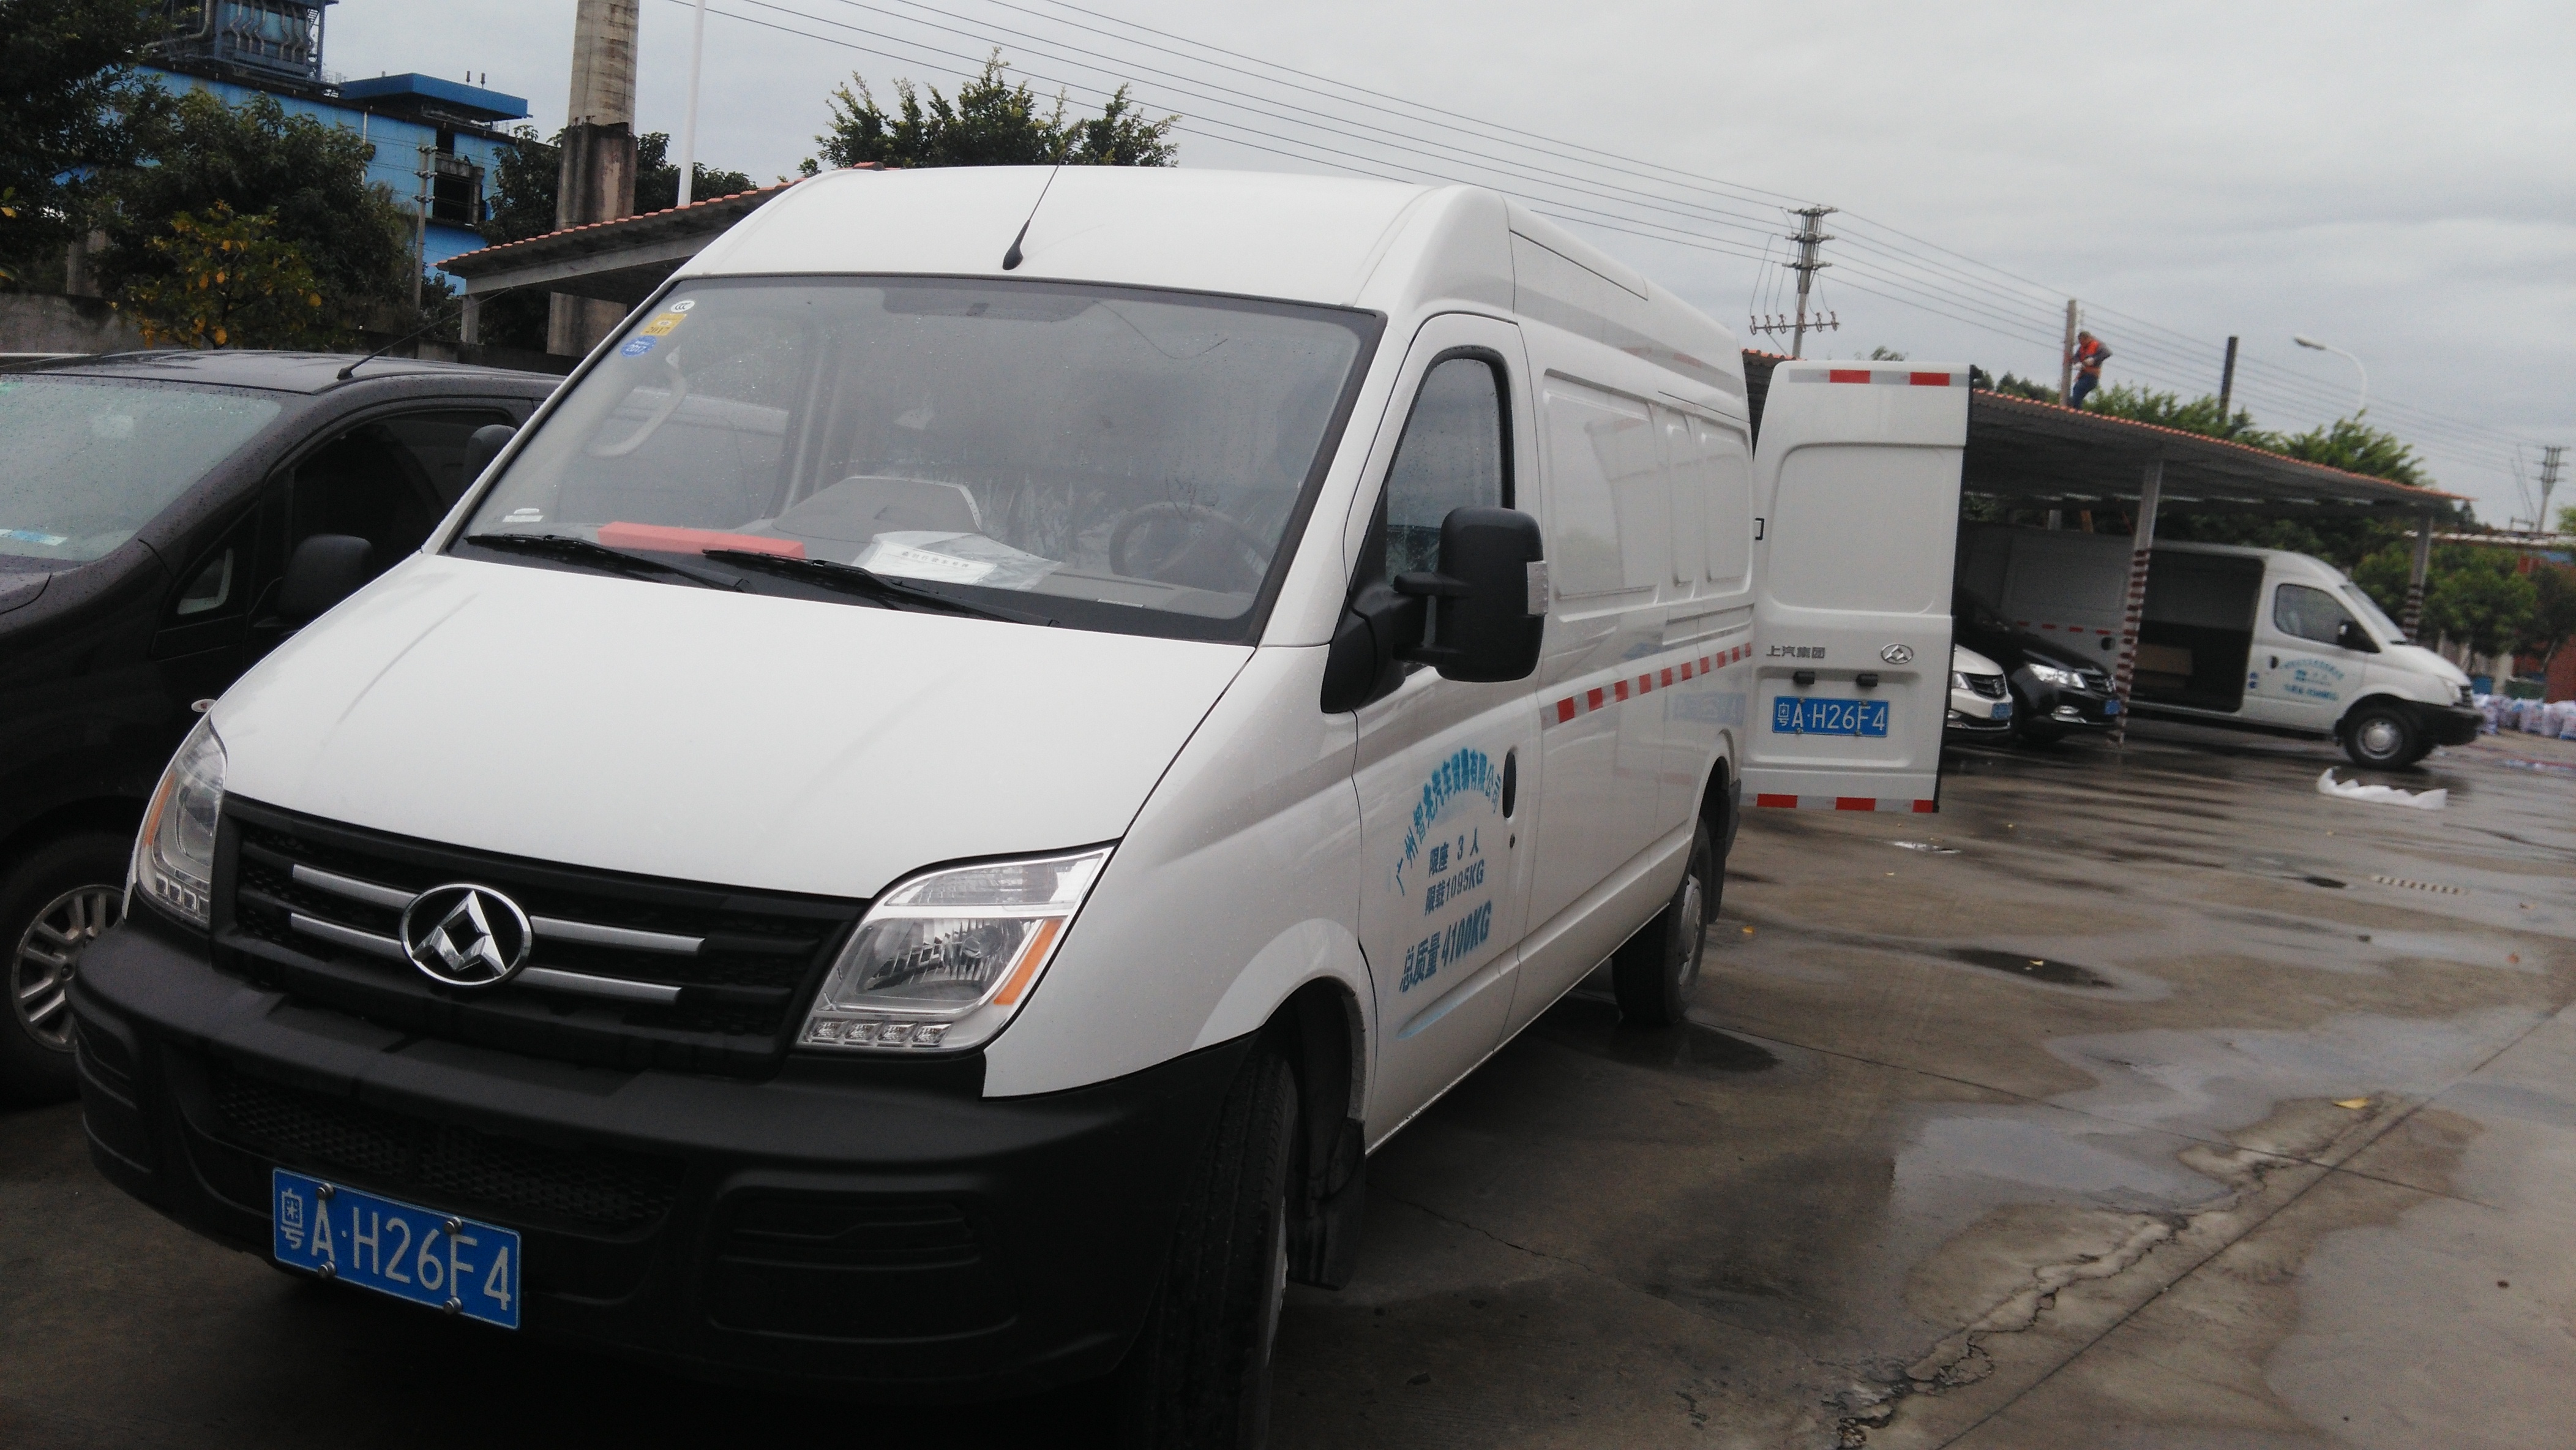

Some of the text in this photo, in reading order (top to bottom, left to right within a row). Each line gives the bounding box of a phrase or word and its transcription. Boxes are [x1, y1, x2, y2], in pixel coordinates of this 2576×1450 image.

[1766, 645, 1826, 659] 上汽集团
[1429, 827, 1479, 877] 限座 3 人
[1399, 900, 1492, 993] 总质量 4100KG
